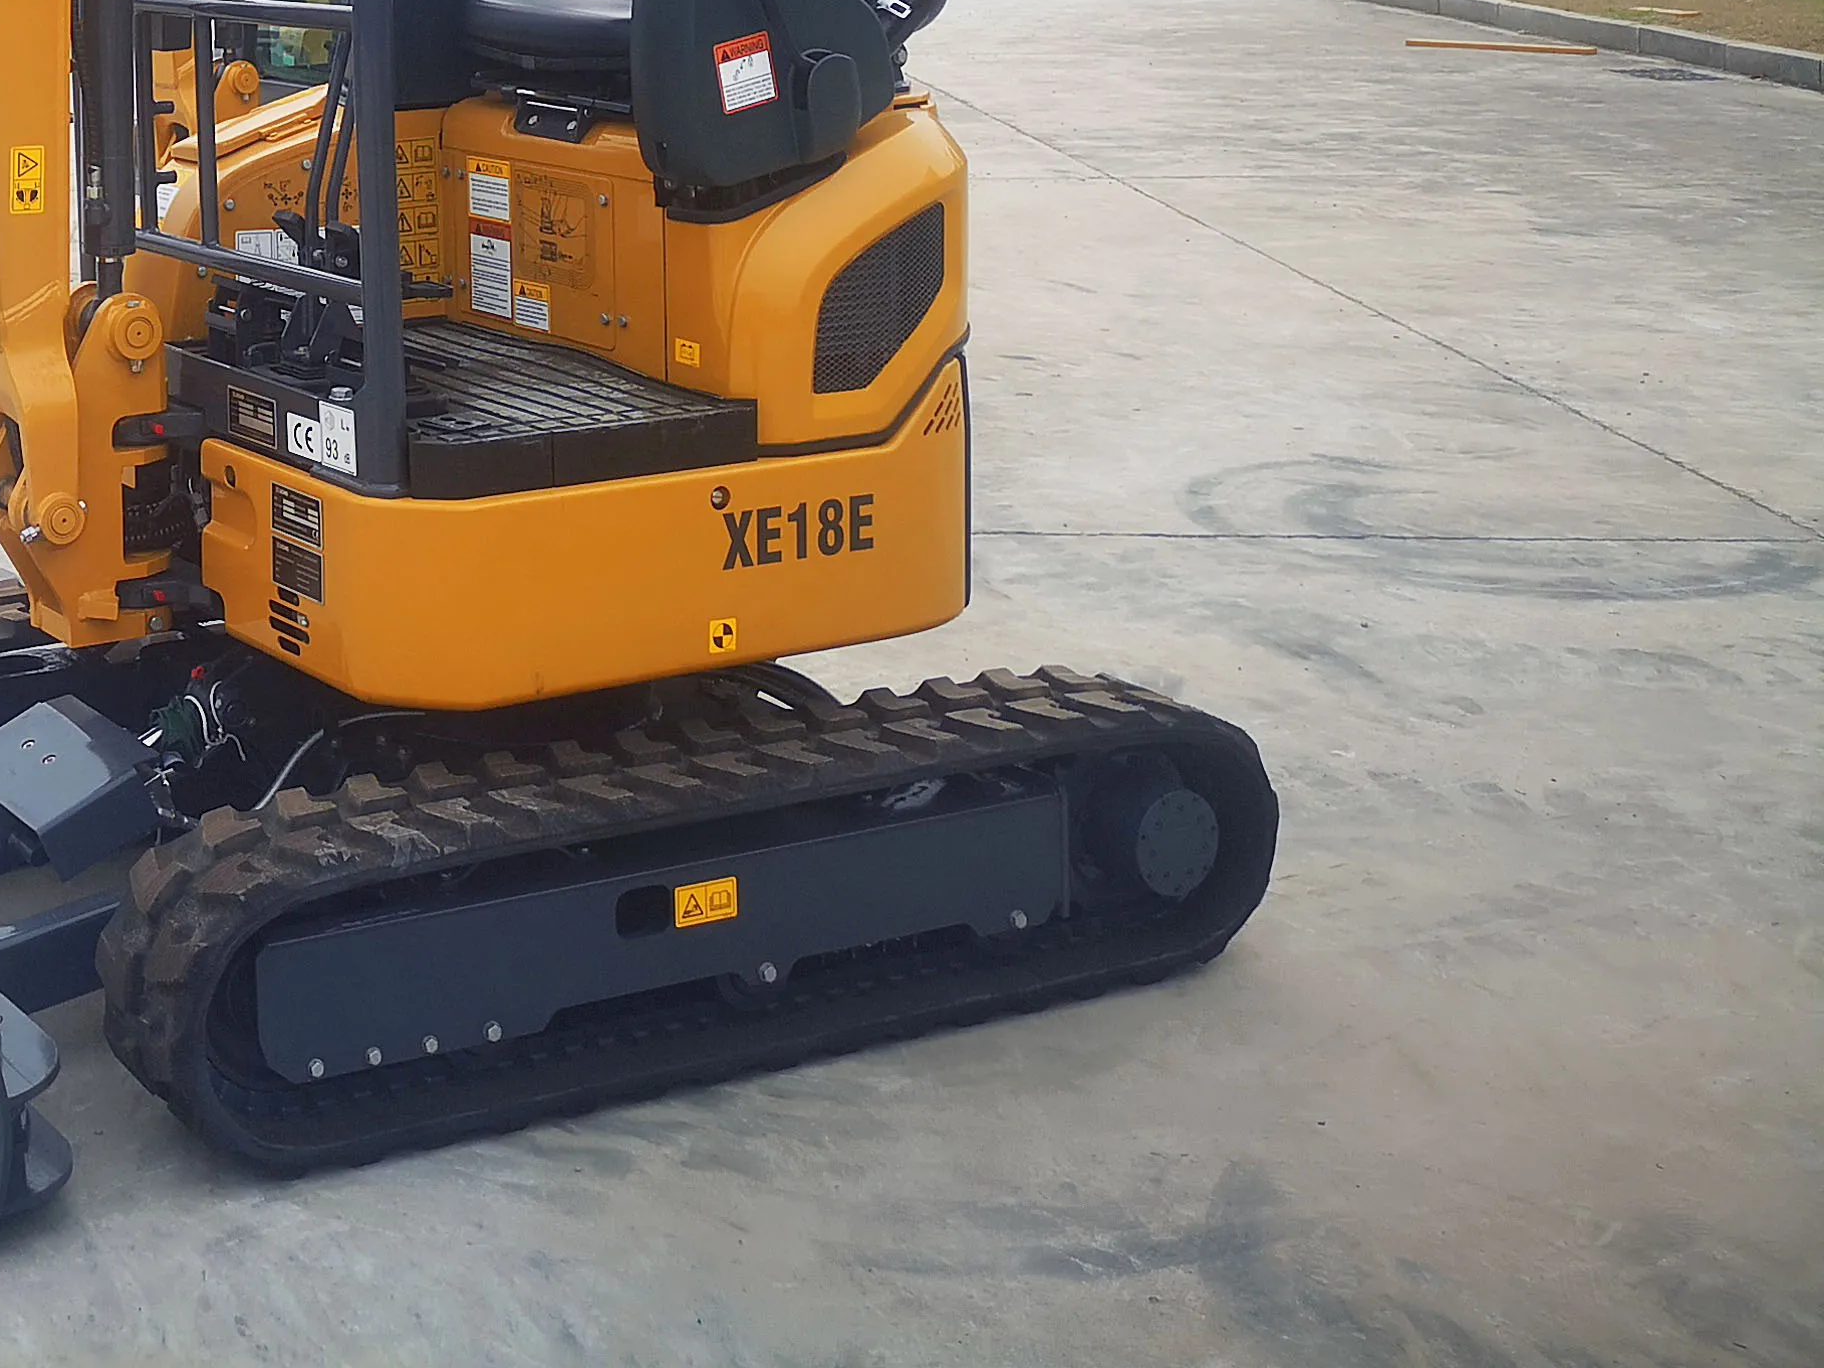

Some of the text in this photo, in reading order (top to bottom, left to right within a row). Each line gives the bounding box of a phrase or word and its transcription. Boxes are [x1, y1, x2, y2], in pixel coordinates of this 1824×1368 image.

[729, 38, 764, 58] WARNING
[293, 422, 314, 453] CE
[325, 437, 339, 460] 93
[722, 493, 875, 571] XE18E
